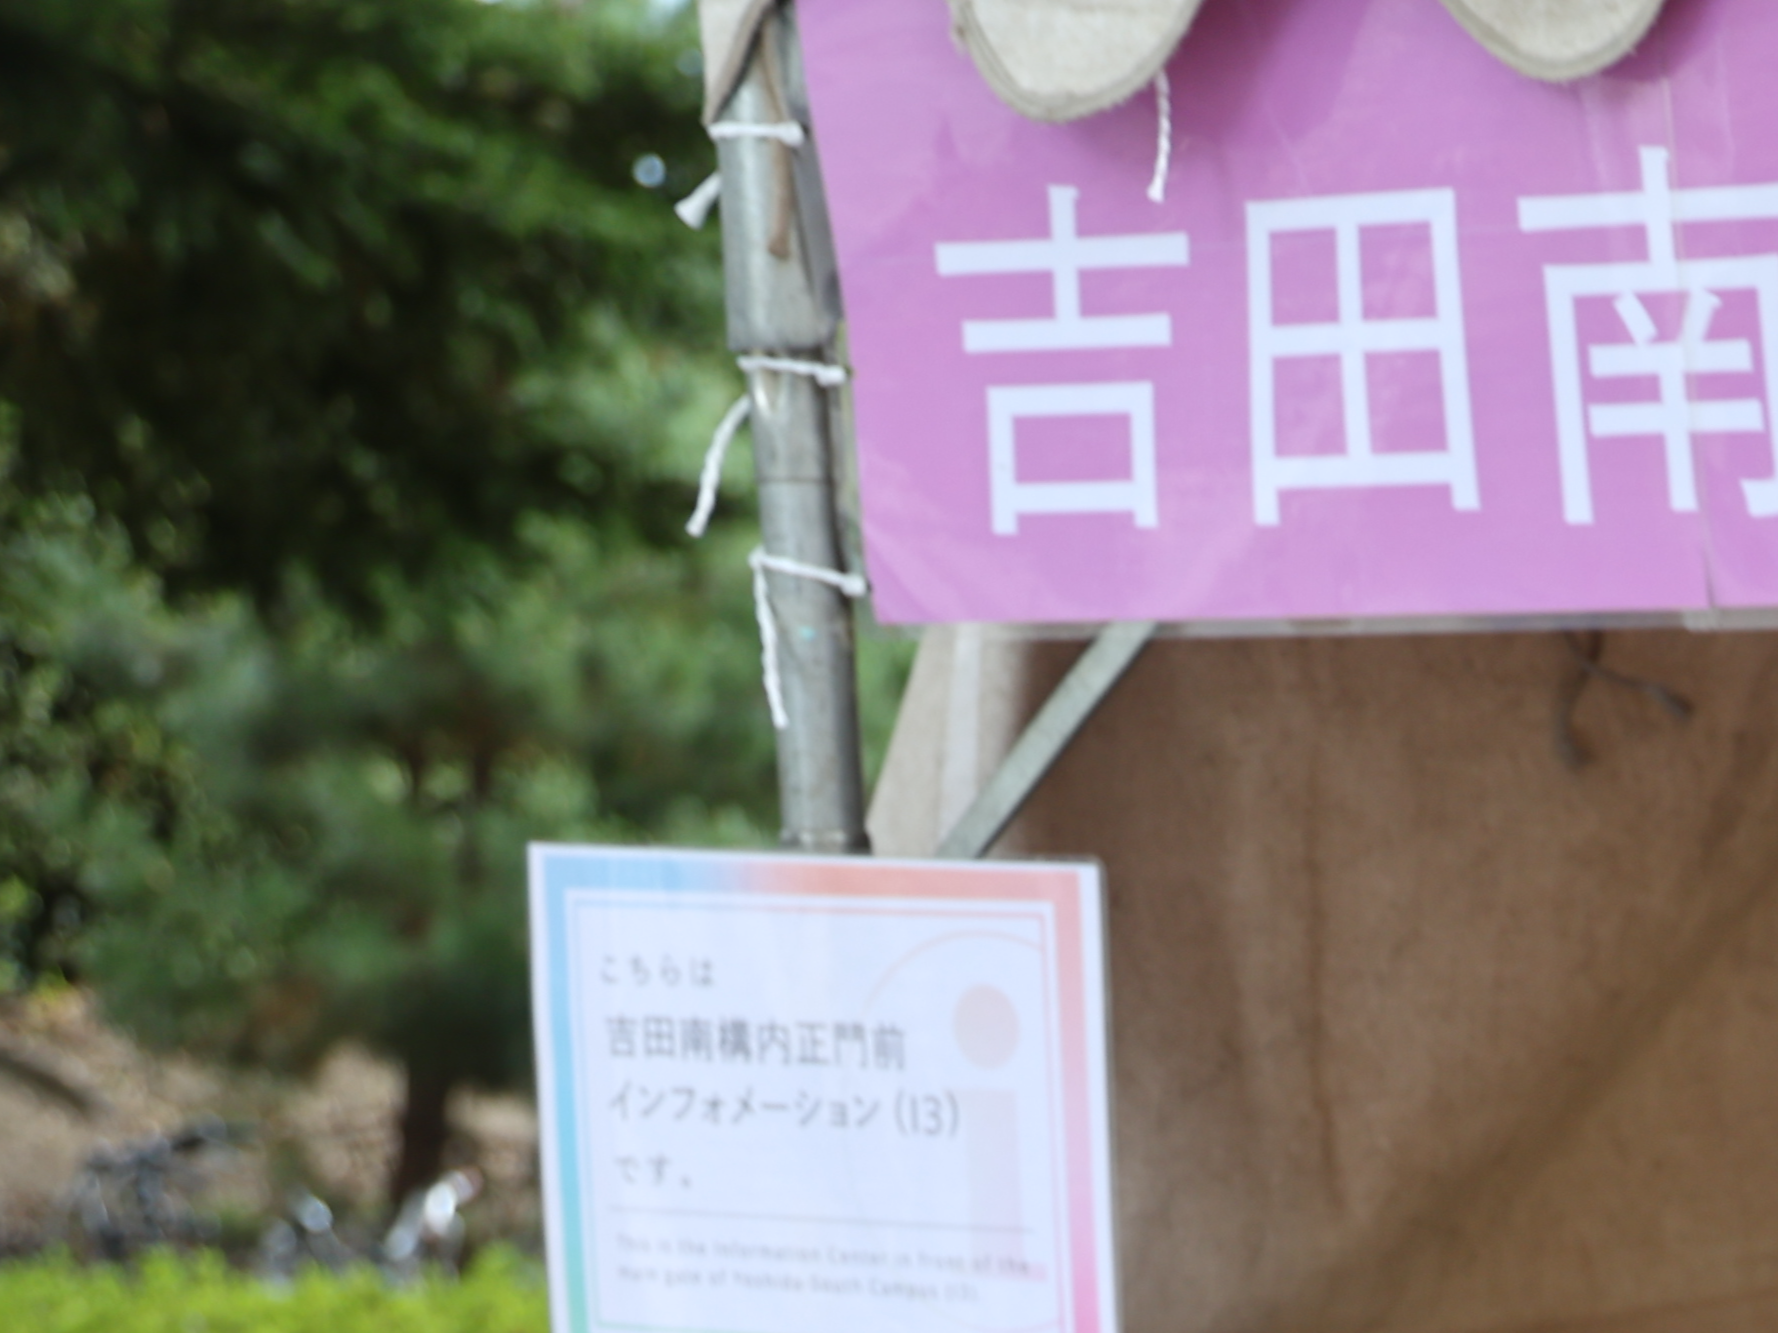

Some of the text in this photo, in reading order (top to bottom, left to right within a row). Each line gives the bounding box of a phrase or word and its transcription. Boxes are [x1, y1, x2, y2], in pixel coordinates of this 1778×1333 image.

[600, 952, 714, 987] こちらは
[605, 1016, 905, 1071] 吉田南構内正門前
[613, 1152, 692, 1189] です。
